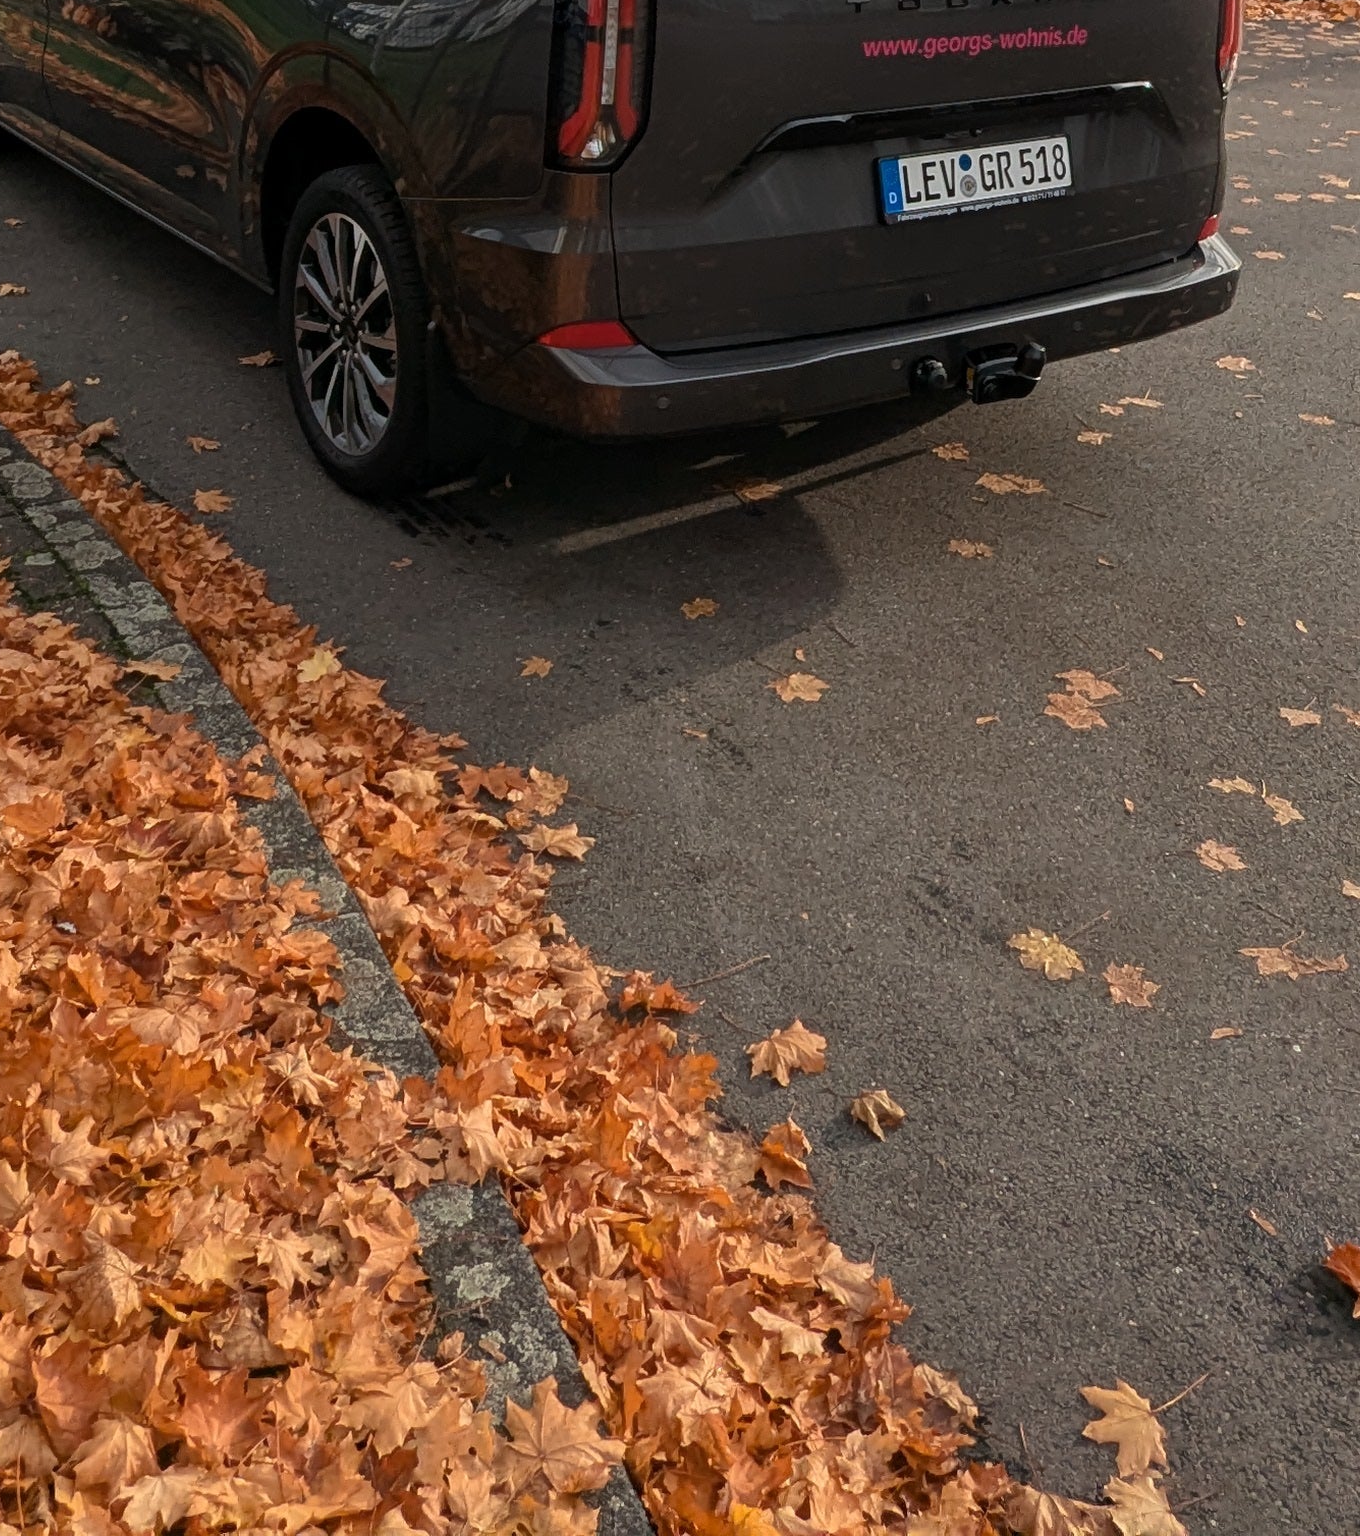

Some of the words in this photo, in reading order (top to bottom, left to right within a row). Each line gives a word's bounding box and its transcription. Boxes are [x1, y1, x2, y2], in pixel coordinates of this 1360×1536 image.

[863, 24, 1088, 59] www.georgs-wohnis.de
[889, 192, 898, 204] D
[903, 158, 956, 204] LEV
[979, 151, 1014, 192] GR
[1019, 144, 1067, 186] 518
